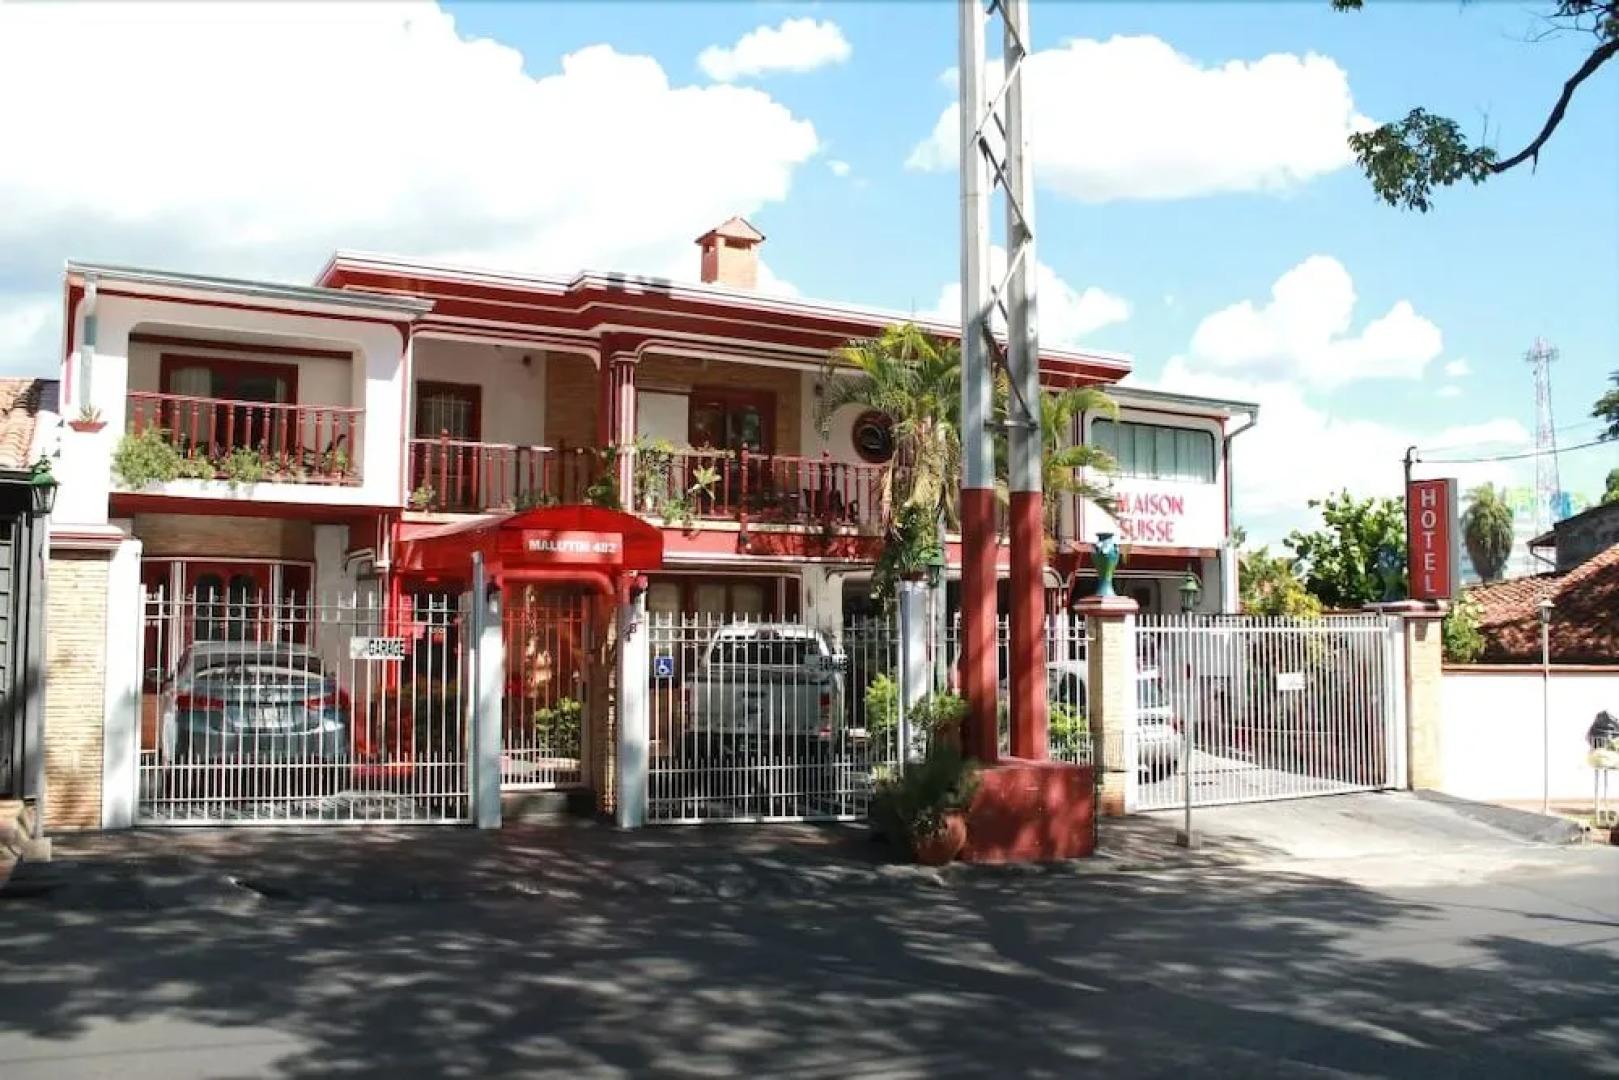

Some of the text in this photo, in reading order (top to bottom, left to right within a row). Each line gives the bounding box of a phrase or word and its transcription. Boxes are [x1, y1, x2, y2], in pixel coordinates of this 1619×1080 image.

[1116, 491, 1184, 516] MAISON
[1119, 517, 1175, 543] SUISSE
[1420, 488, 1437, 592] HOTEL
